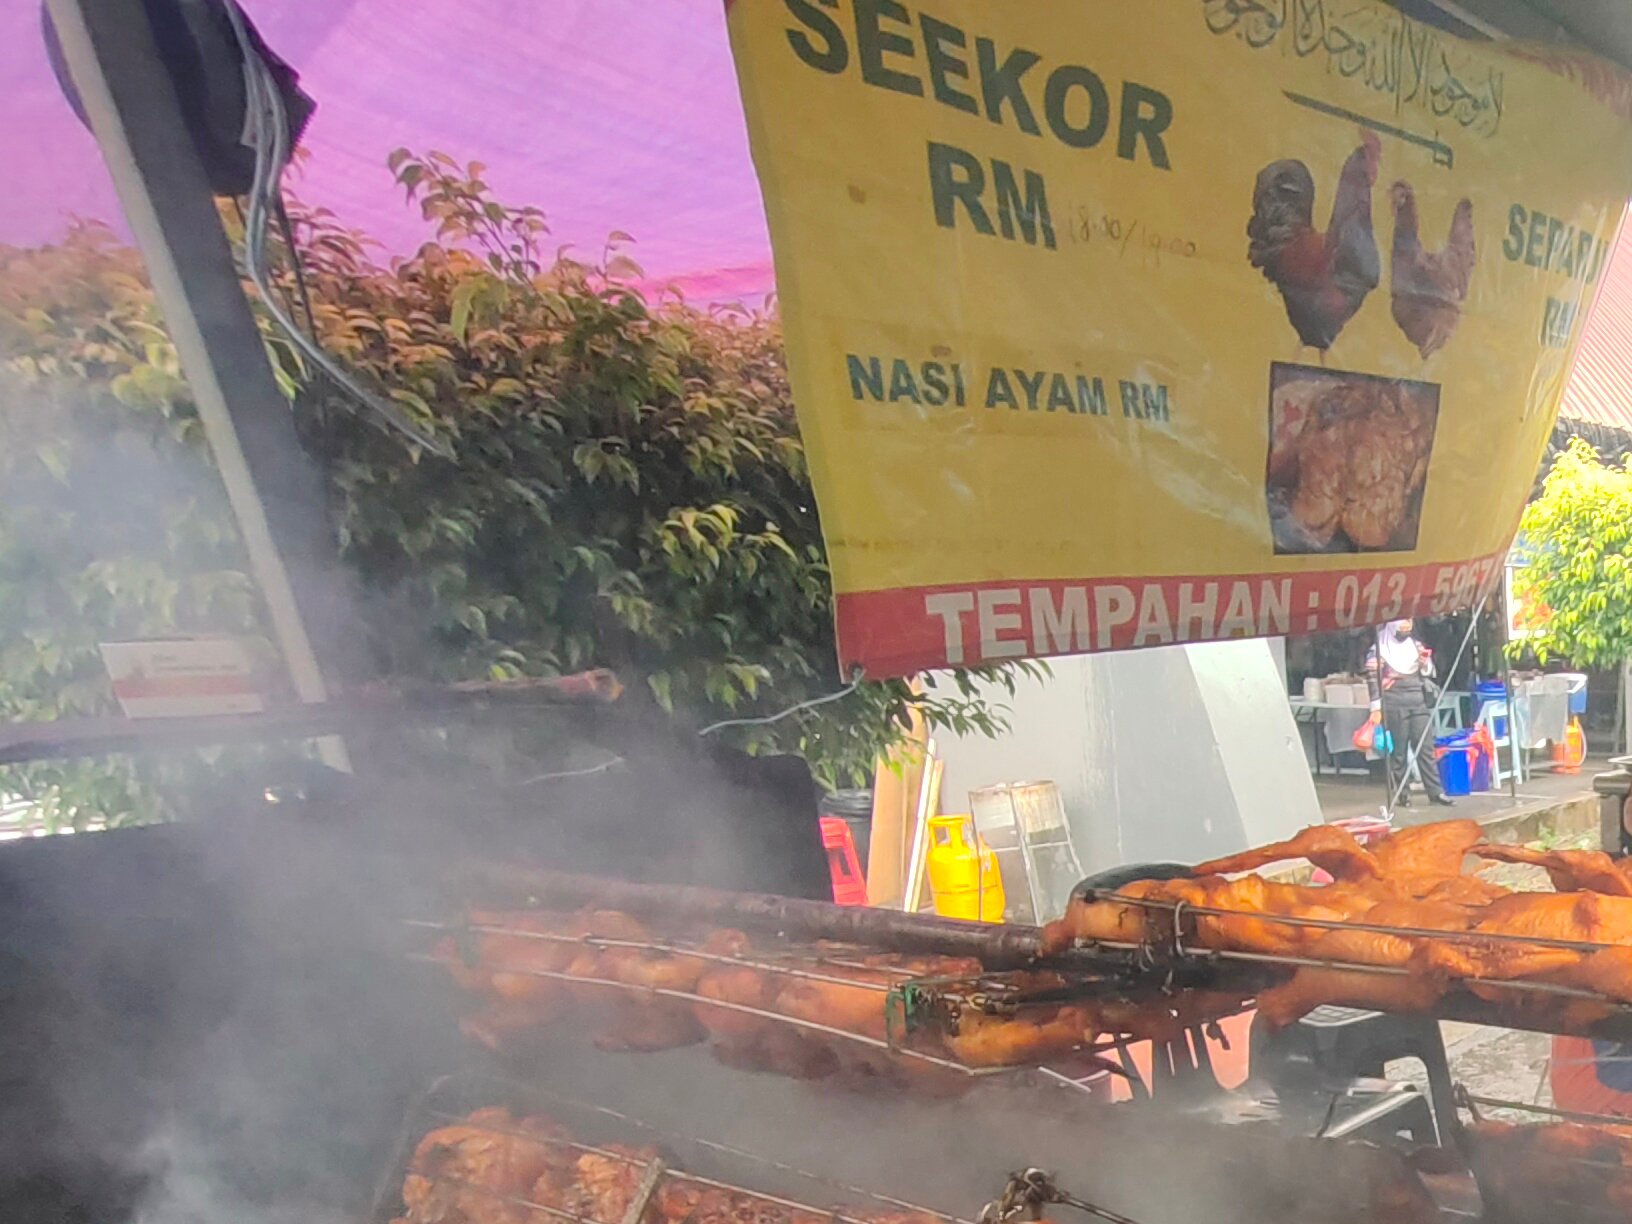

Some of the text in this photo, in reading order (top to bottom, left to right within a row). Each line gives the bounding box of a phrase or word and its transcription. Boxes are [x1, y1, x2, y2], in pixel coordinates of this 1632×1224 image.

[786, 0, 1173, 171] SEEKOR
[926, 140, 1057, 250] RM
[846, 354, 1171, 422] NASI AYAM RM
[925, 577, 1293, 665] TEMPAHAN
[1334, 572, 1407, 629] 013
